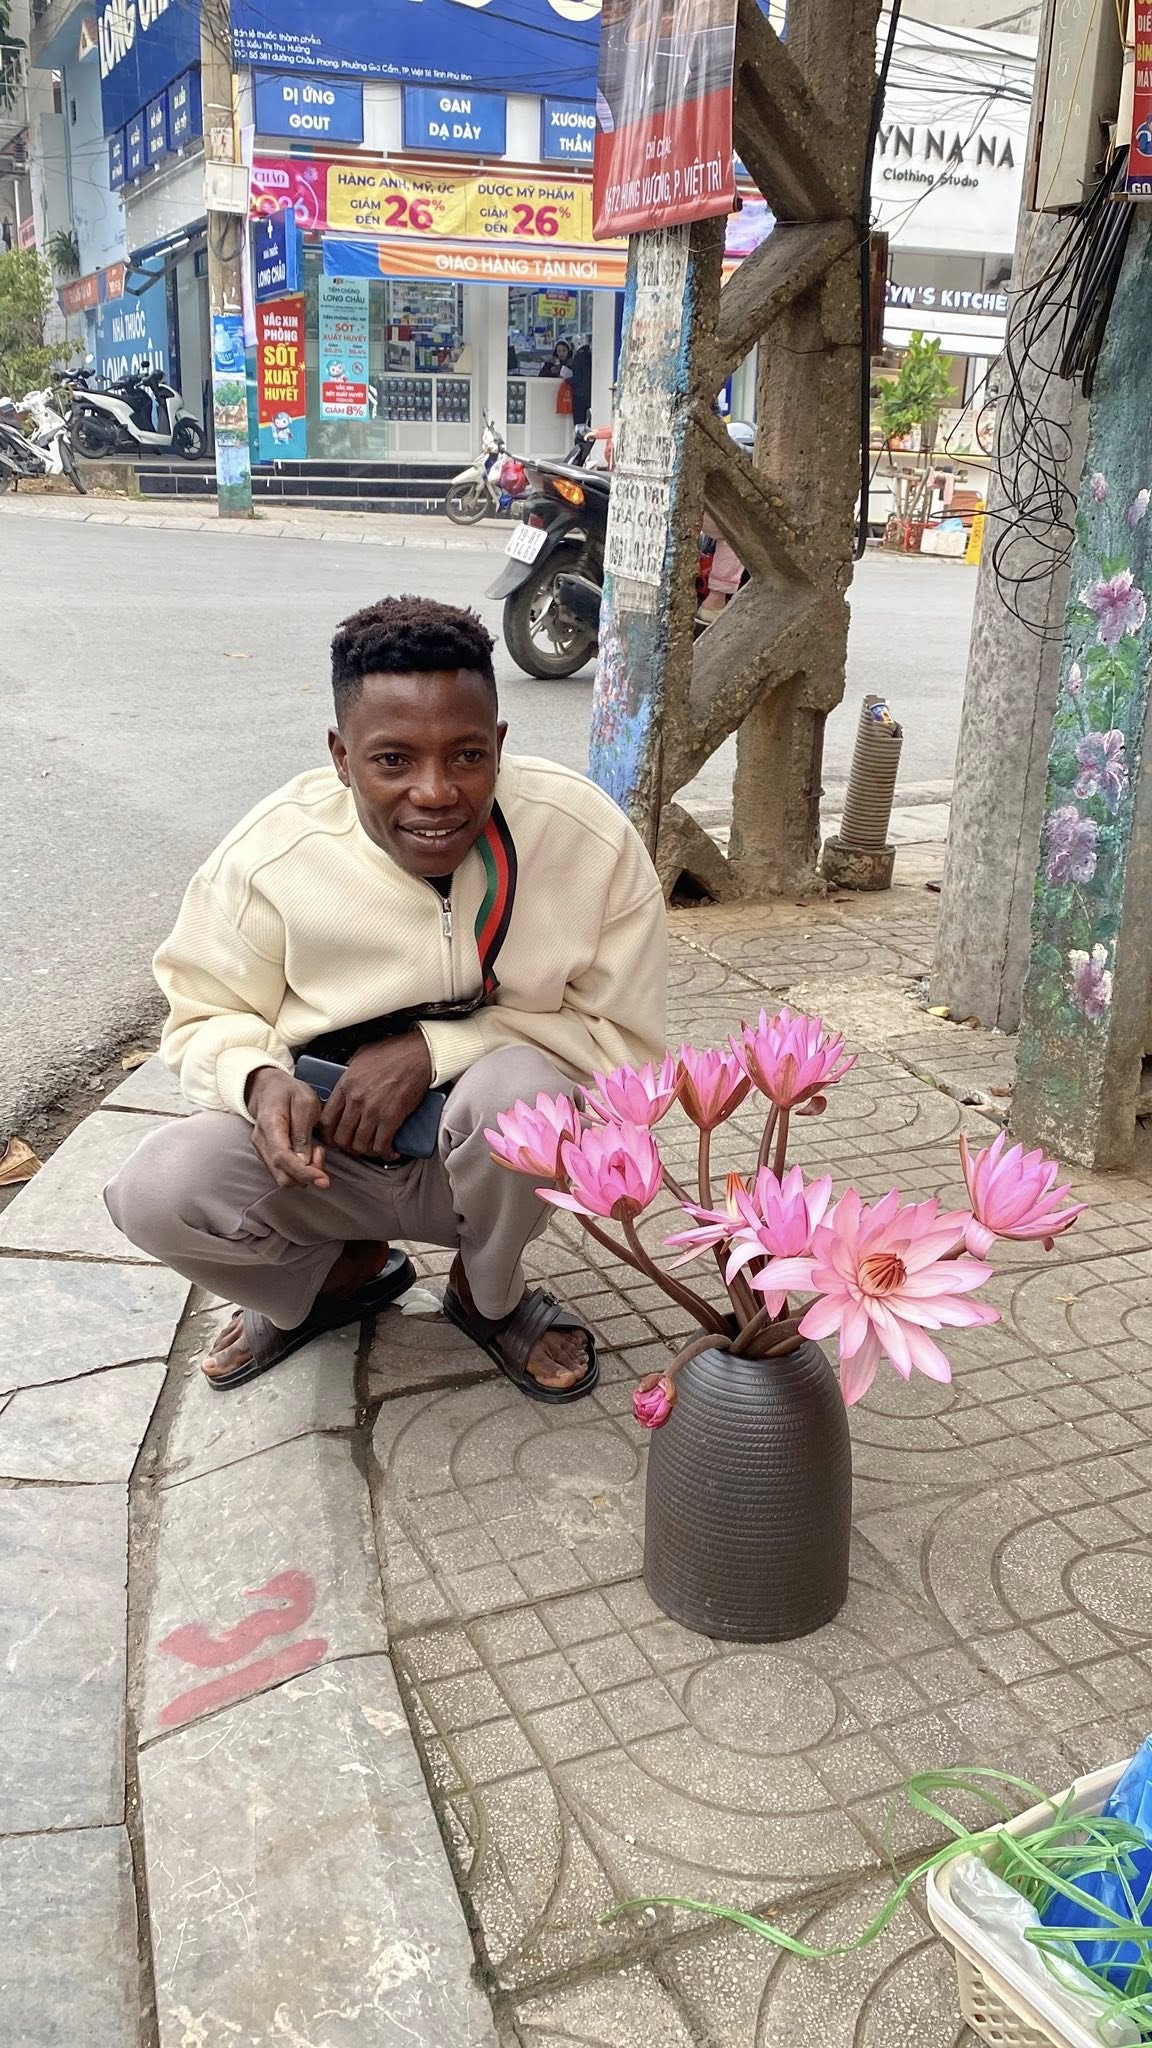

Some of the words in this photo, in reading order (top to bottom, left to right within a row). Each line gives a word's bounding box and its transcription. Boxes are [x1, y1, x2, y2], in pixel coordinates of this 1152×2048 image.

[98, 0, 136, 79] LONG
[295, 54, 316, 65] Châu
[283, 87, 298, 105] DỊ
[302, 85, 335, 105] ỨNG
[439, 97, 472, 114] GAN
[289, 113, 331, 131] GOUT
[550, 109, 596, 129] XƯƠNG
[428, 123, 450, 143] DẠ
[453, 119, 481, 140] DÀY
[559, 134, 592, 153] THẦN
[925, 128, 964, 163] NA
[976, 134, 1015, 168] NA
[254, 169, 285, 183] CHÀO
[337, 171, 376, 187] HÀNG
[379, 176, 410, 191] ANH,
[412, 180, 434, 194] MỸ,
[437, 181, 455, 194] ÚC
[620, 177, 641, 210] HÙNG
[642, 169, 672, 206] VƯƠNG,
[673, 169, 682, 199] P.
[684, 157, 705, 197] VIỆT
[706, 151, 722, 192] TRÌ
[883, 167, 934, 186] Clothing
[939, 172, 979, 188] Studio
[477, 184, 513, 199] DƯỢC
[516, 186, 535, 198] MỸ
[538, 185, 575, 201] PHẨM
[349, 196, 381, 210] GIẢM
[479, 204, 508, 219] GIẢM
[355, 211, 380, 225] ĐẾN
[484, 220, 508, 233] ĐẾN
[257, 266, 271, 288] LONG
[271, 259, 286, 284] CHÂU
[434, 254, 478, 272] GIAO
[481, 251, 529, 275] HÀNG
[533, 255, 568, 281] TẬN
[569, 260, 598, 280] NƠI
[322, 294, 344, 302] LONG
[345, 295, 365, 304] CHÂU
[112, 308, 125, 342] NHÀ
[125, 299, 146, 342] THUỐC
[263, 311, 282, 327] VẮC
[282, 315, 298, 327] XIN
[335, 320, 354, 332] SỐT
[264, 326, 298, 342] PHÒNG
[322, 332, 343, 341] XUẤT
[343, 333, 367, 342] HUYẾT
[263, 342, 298, 367] SỐT
[264, 367, 299, 386] XUẤT
[264, 385, 299, 401] HUYẾT
[325, 405, 345, 414] GIẢM
[346, 405, 364, 417] 8%
